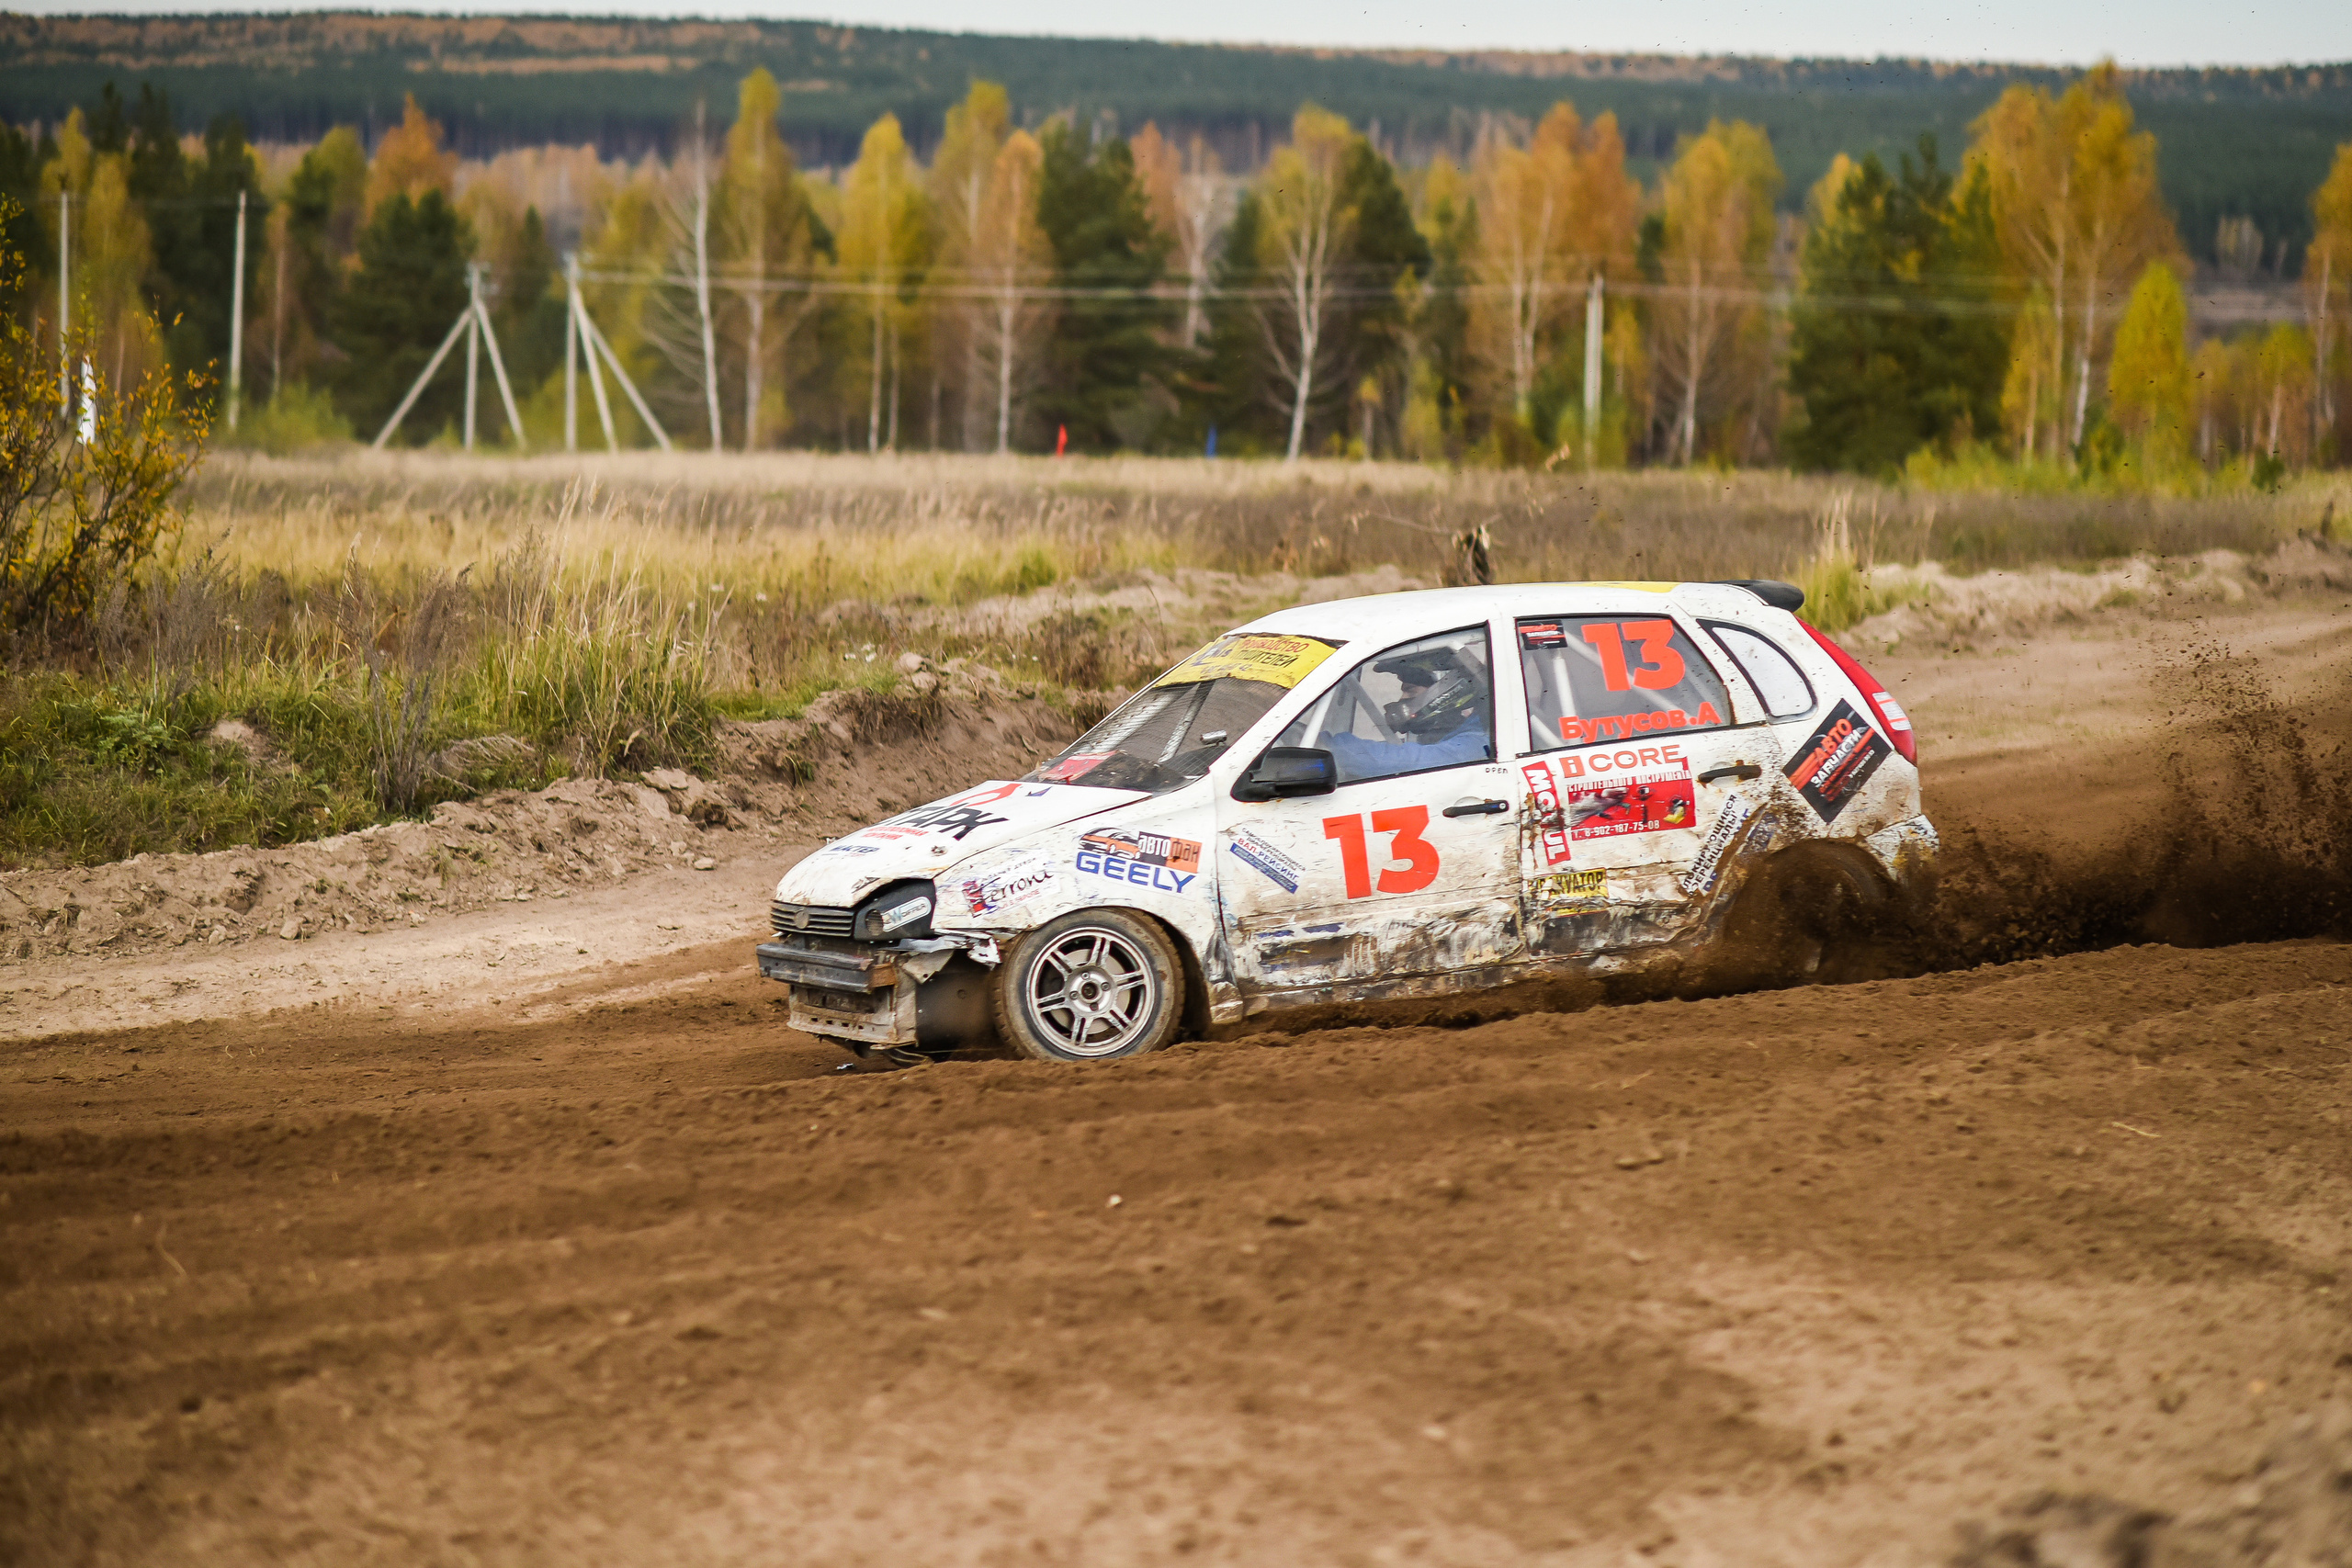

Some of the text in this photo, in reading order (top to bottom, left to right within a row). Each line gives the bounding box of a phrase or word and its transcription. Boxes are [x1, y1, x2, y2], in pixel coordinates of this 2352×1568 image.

[1580, 619, 1687, 692] 13
[1810, 729, 1862, 788] ЗАПЧАСТИ
[1814, 717, 1853, 766] АВТО
[1525, 769, 1567, 860] MOUL
[1076, 851, 1196, 894] GEELY
[1322, 805, 1442, 899] 13
